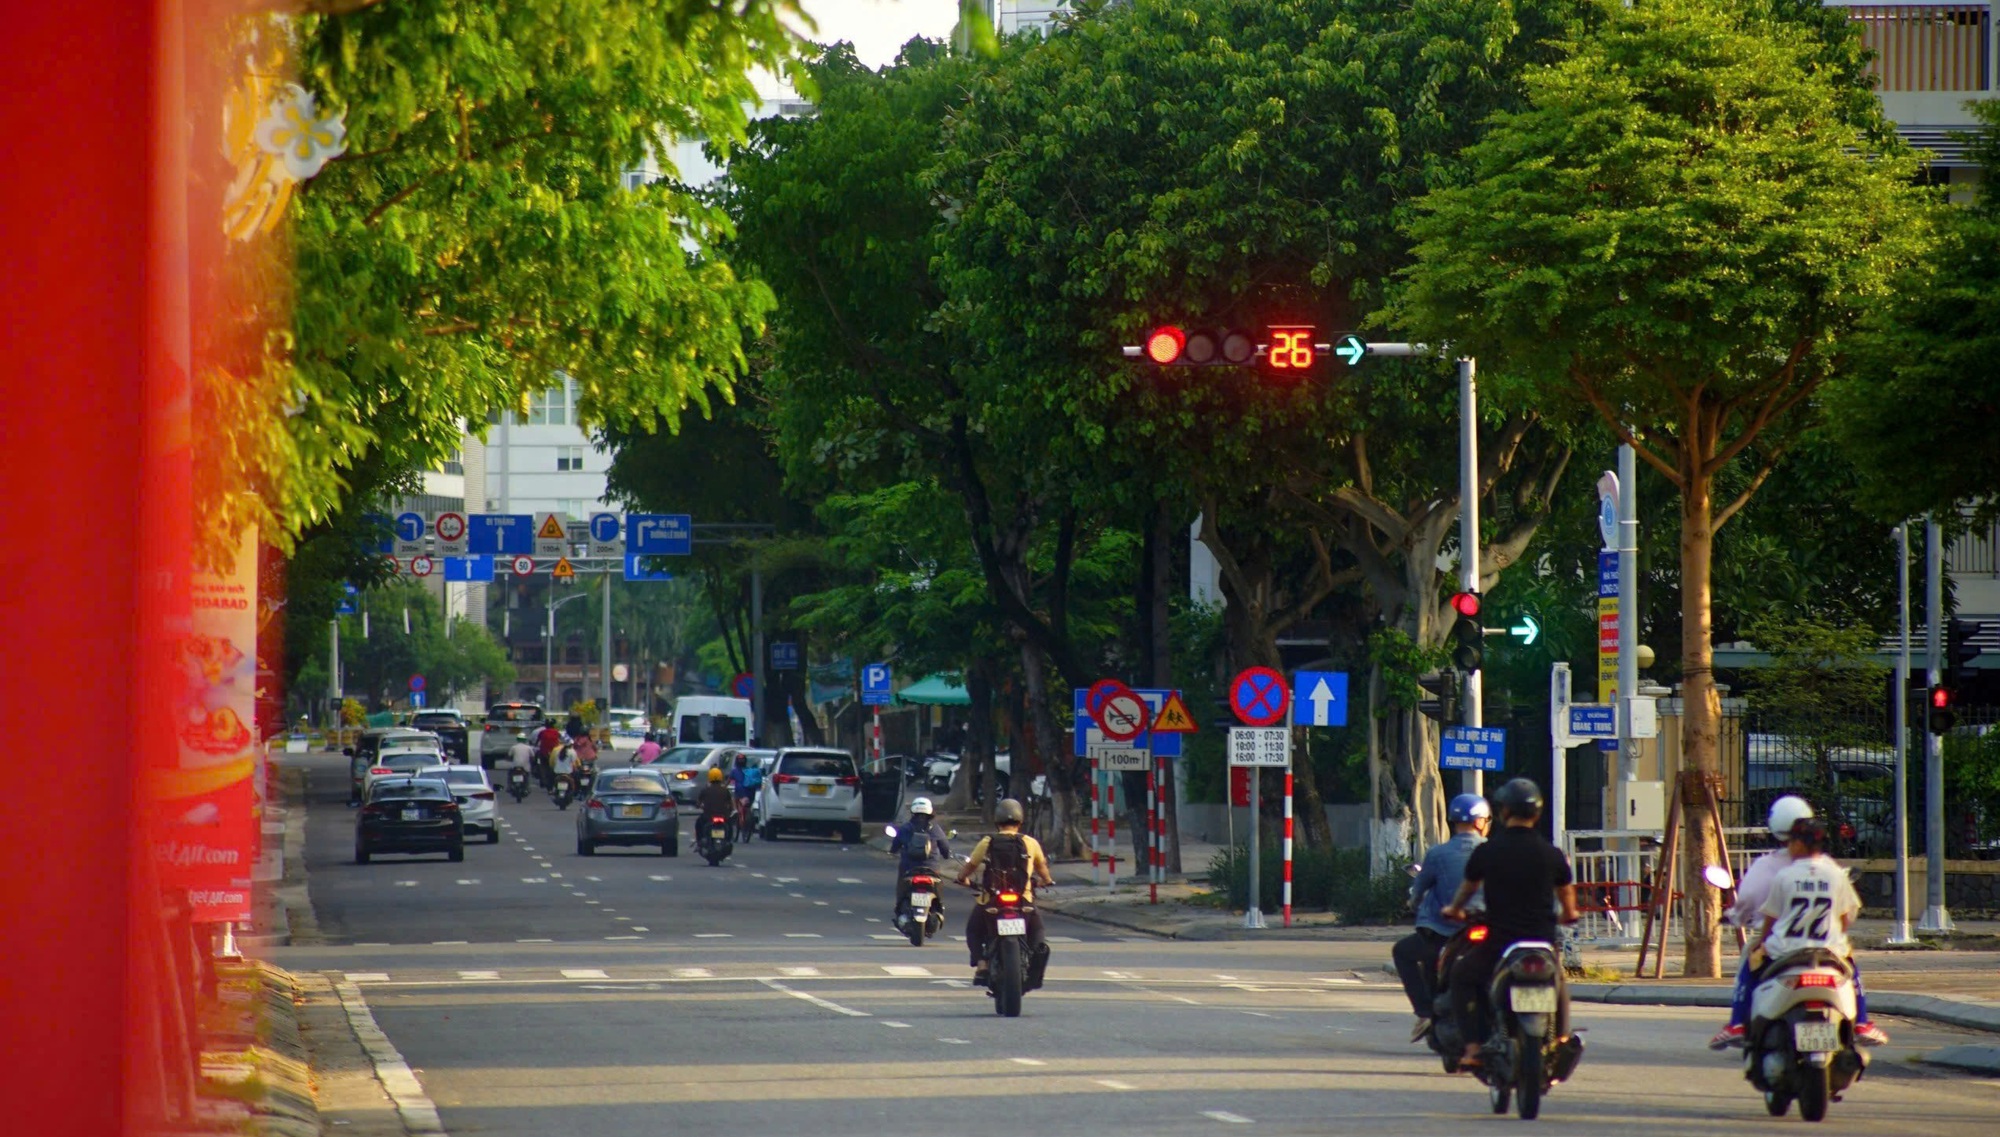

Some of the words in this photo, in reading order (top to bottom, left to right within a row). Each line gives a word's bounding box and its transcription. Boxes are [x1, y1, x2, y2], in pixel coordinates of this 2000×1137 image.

[1269, 333, 1312, 368] 26
[518, 561, 528, 570] 50
[869, 668, 885, 688] P
[1235, 730, 1255, 740] 06:00
[1264, 731, 1284, 740] 07:30
[1264, 742, 1284, 751] 11:30
[1235, 752, 1255, 762] 16:00
[1264, 753, 1284, 762] 17:30
[1784, 897, 1833, 941] 22
